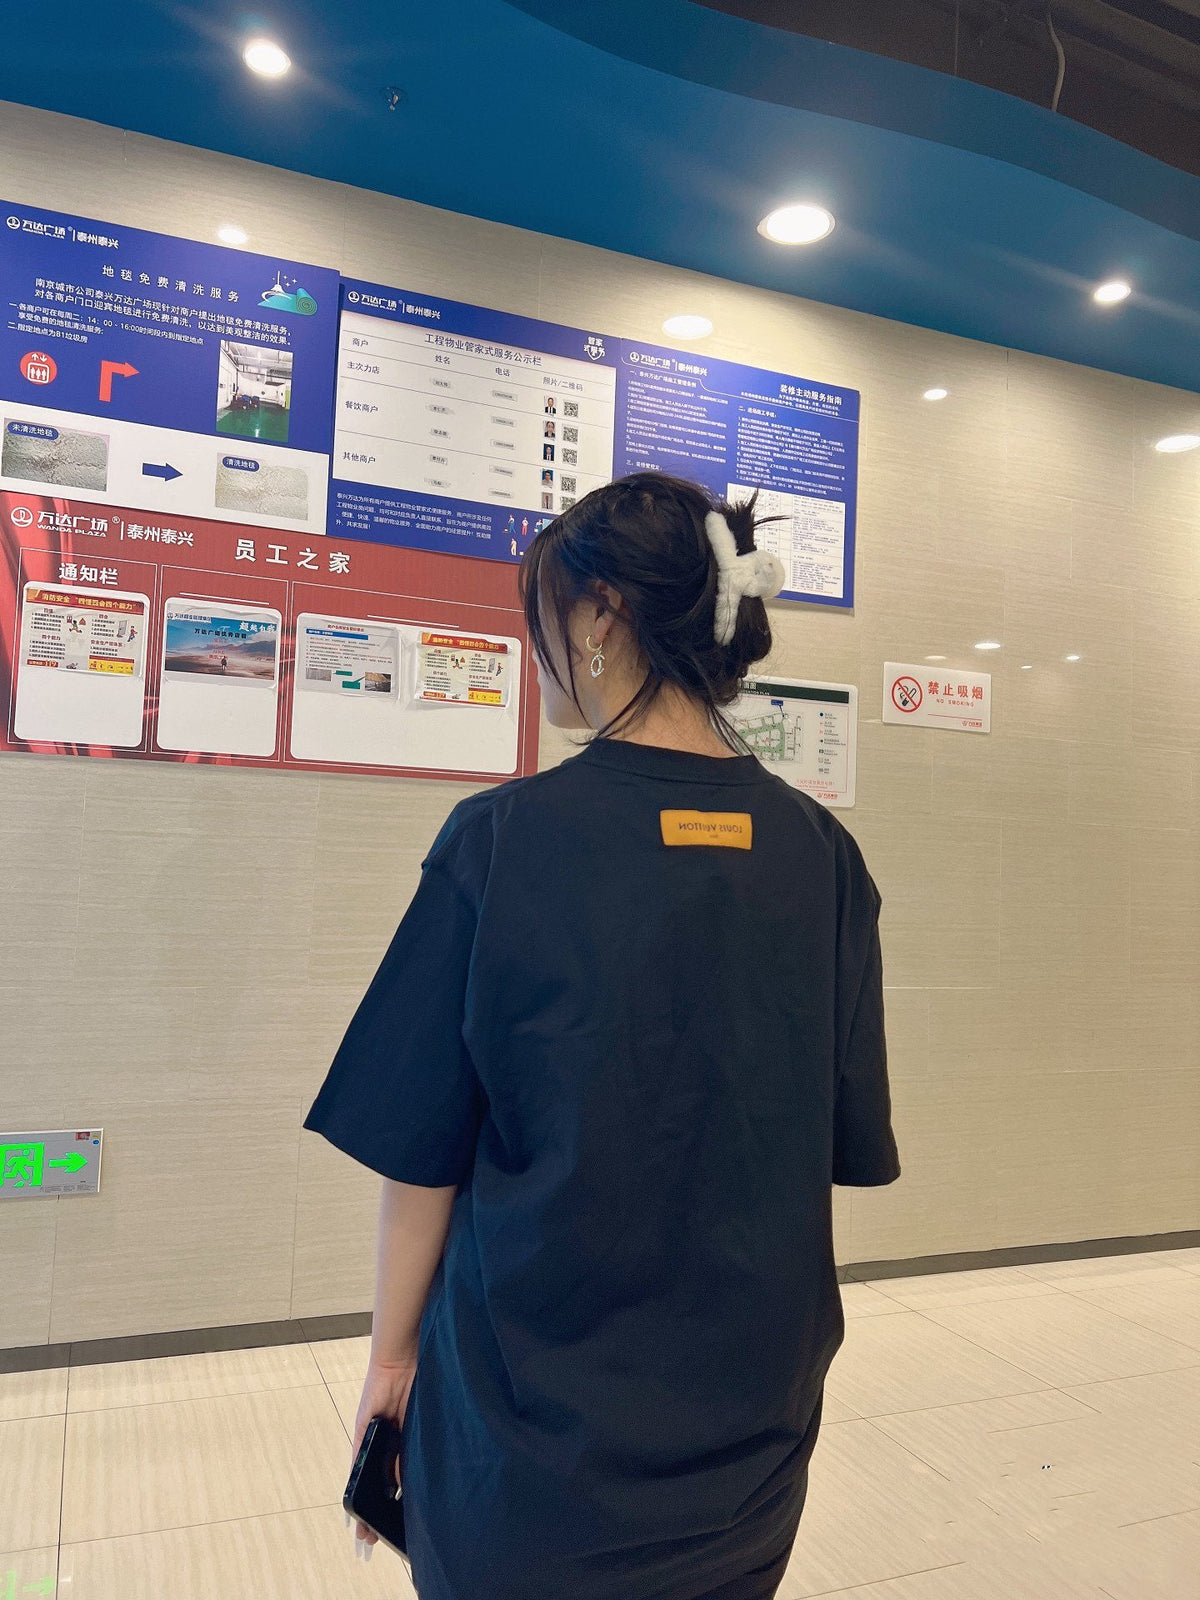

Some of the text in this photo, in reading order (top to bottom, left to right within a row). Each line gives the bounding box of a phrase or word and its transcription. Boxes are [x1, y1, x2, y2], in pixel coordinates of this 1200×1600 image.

[22, 219, 66, 236] 万达广场
[77, 231, 119, 249] 泰州泰兴
[102, 264, 240, 303] 地毯免费清洗服务
[406, 304, 441, 320] 泰州泰兴
[352, 337, 369, 348] 商户
[424, 333, 542, 367] 工程物业管家式服务公示栏
[347, 361, 380, 375] 主次力店
[434, 355, 451, 365] 姓名
[495, 367, 511, 377] 电话
[345, 401, 379, 414] 餐饮商户
[12, 423, 53, 438] 未清洗地毯
[226, 458, 256, 470] 清洗地毯
[342, 451, 376, 464] 其他商户
[37, 511, 108, 532] 万达广场
[37, 524, 107, 538] WANDA PLAZA
[127, 524, 194, 547] 泰州泰兴
[235, 538, 351, 574] 员工之家
[58, 562, 118, 585] 通知栏
[928, 680, 983, 700] 禁止吸烟
[948, 699, 975, 708] SMOKING
